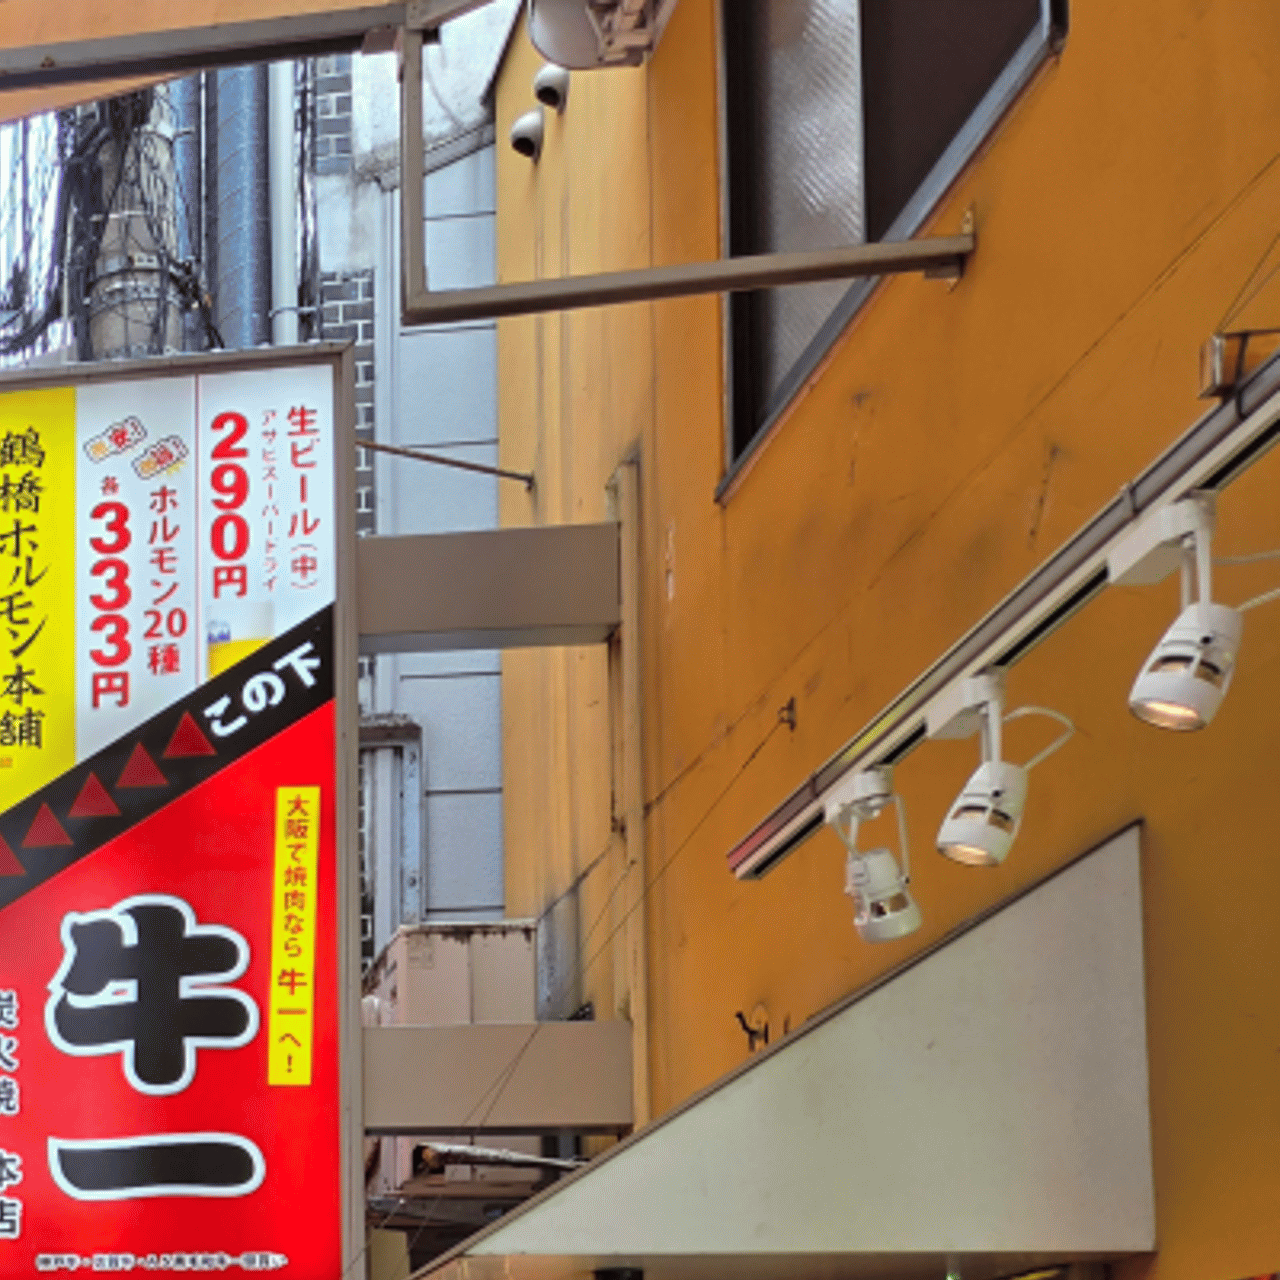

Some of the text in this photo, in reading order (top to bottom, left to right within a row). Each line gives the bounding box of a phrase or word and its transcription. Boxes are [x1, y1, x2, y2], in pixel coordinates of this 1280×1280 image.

[142, 486, 188, 675] ホルモン20種
[210, 411, 249, 598] 290円
[262, 410, 280, 592] アサヒスーパードライ
[89, 501, 132, 709] 333円
[203, 642, 322, 738] この下
[44, 893, 267, 1200] 牛一
